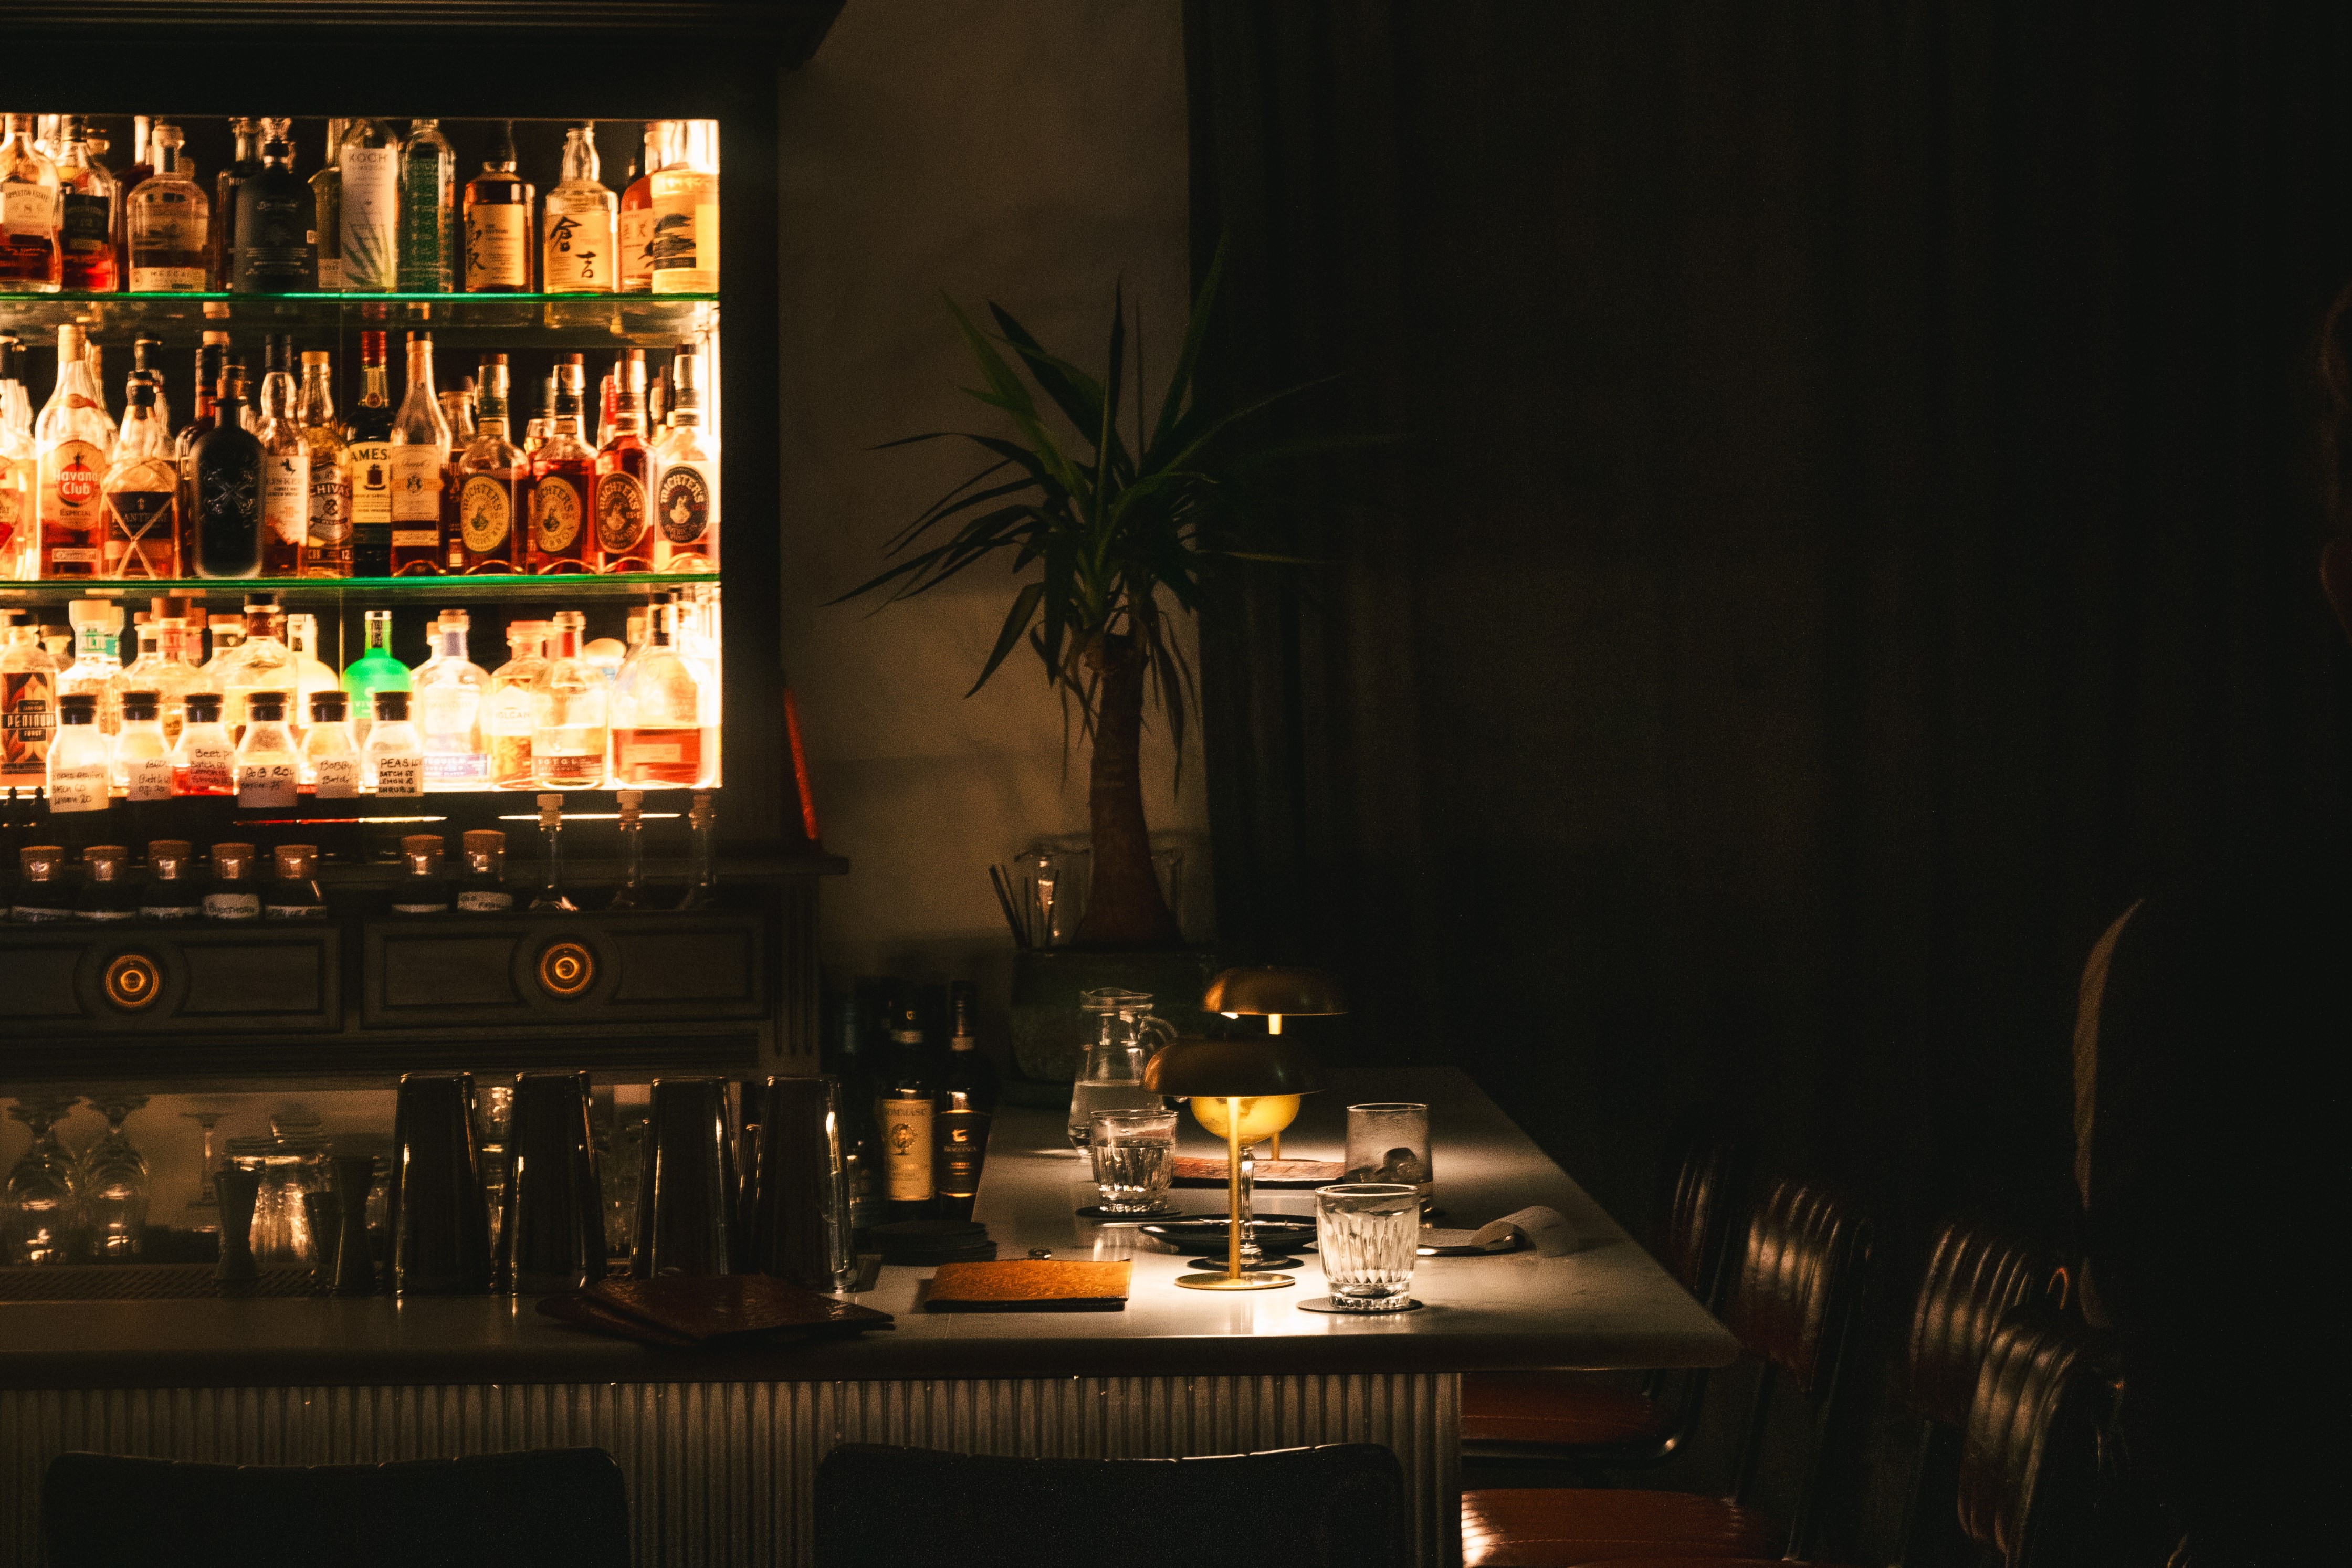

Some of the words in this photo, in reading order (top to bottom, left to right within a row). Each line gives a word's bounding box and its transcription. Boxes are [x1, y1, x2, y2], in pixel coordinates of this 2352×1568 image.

[349, 153, 388, 162] KOCH
[54, 470, 99, 481] Havana
[62, 482, 90, 494] Club
[381, 758, 409, 768] PEAS
